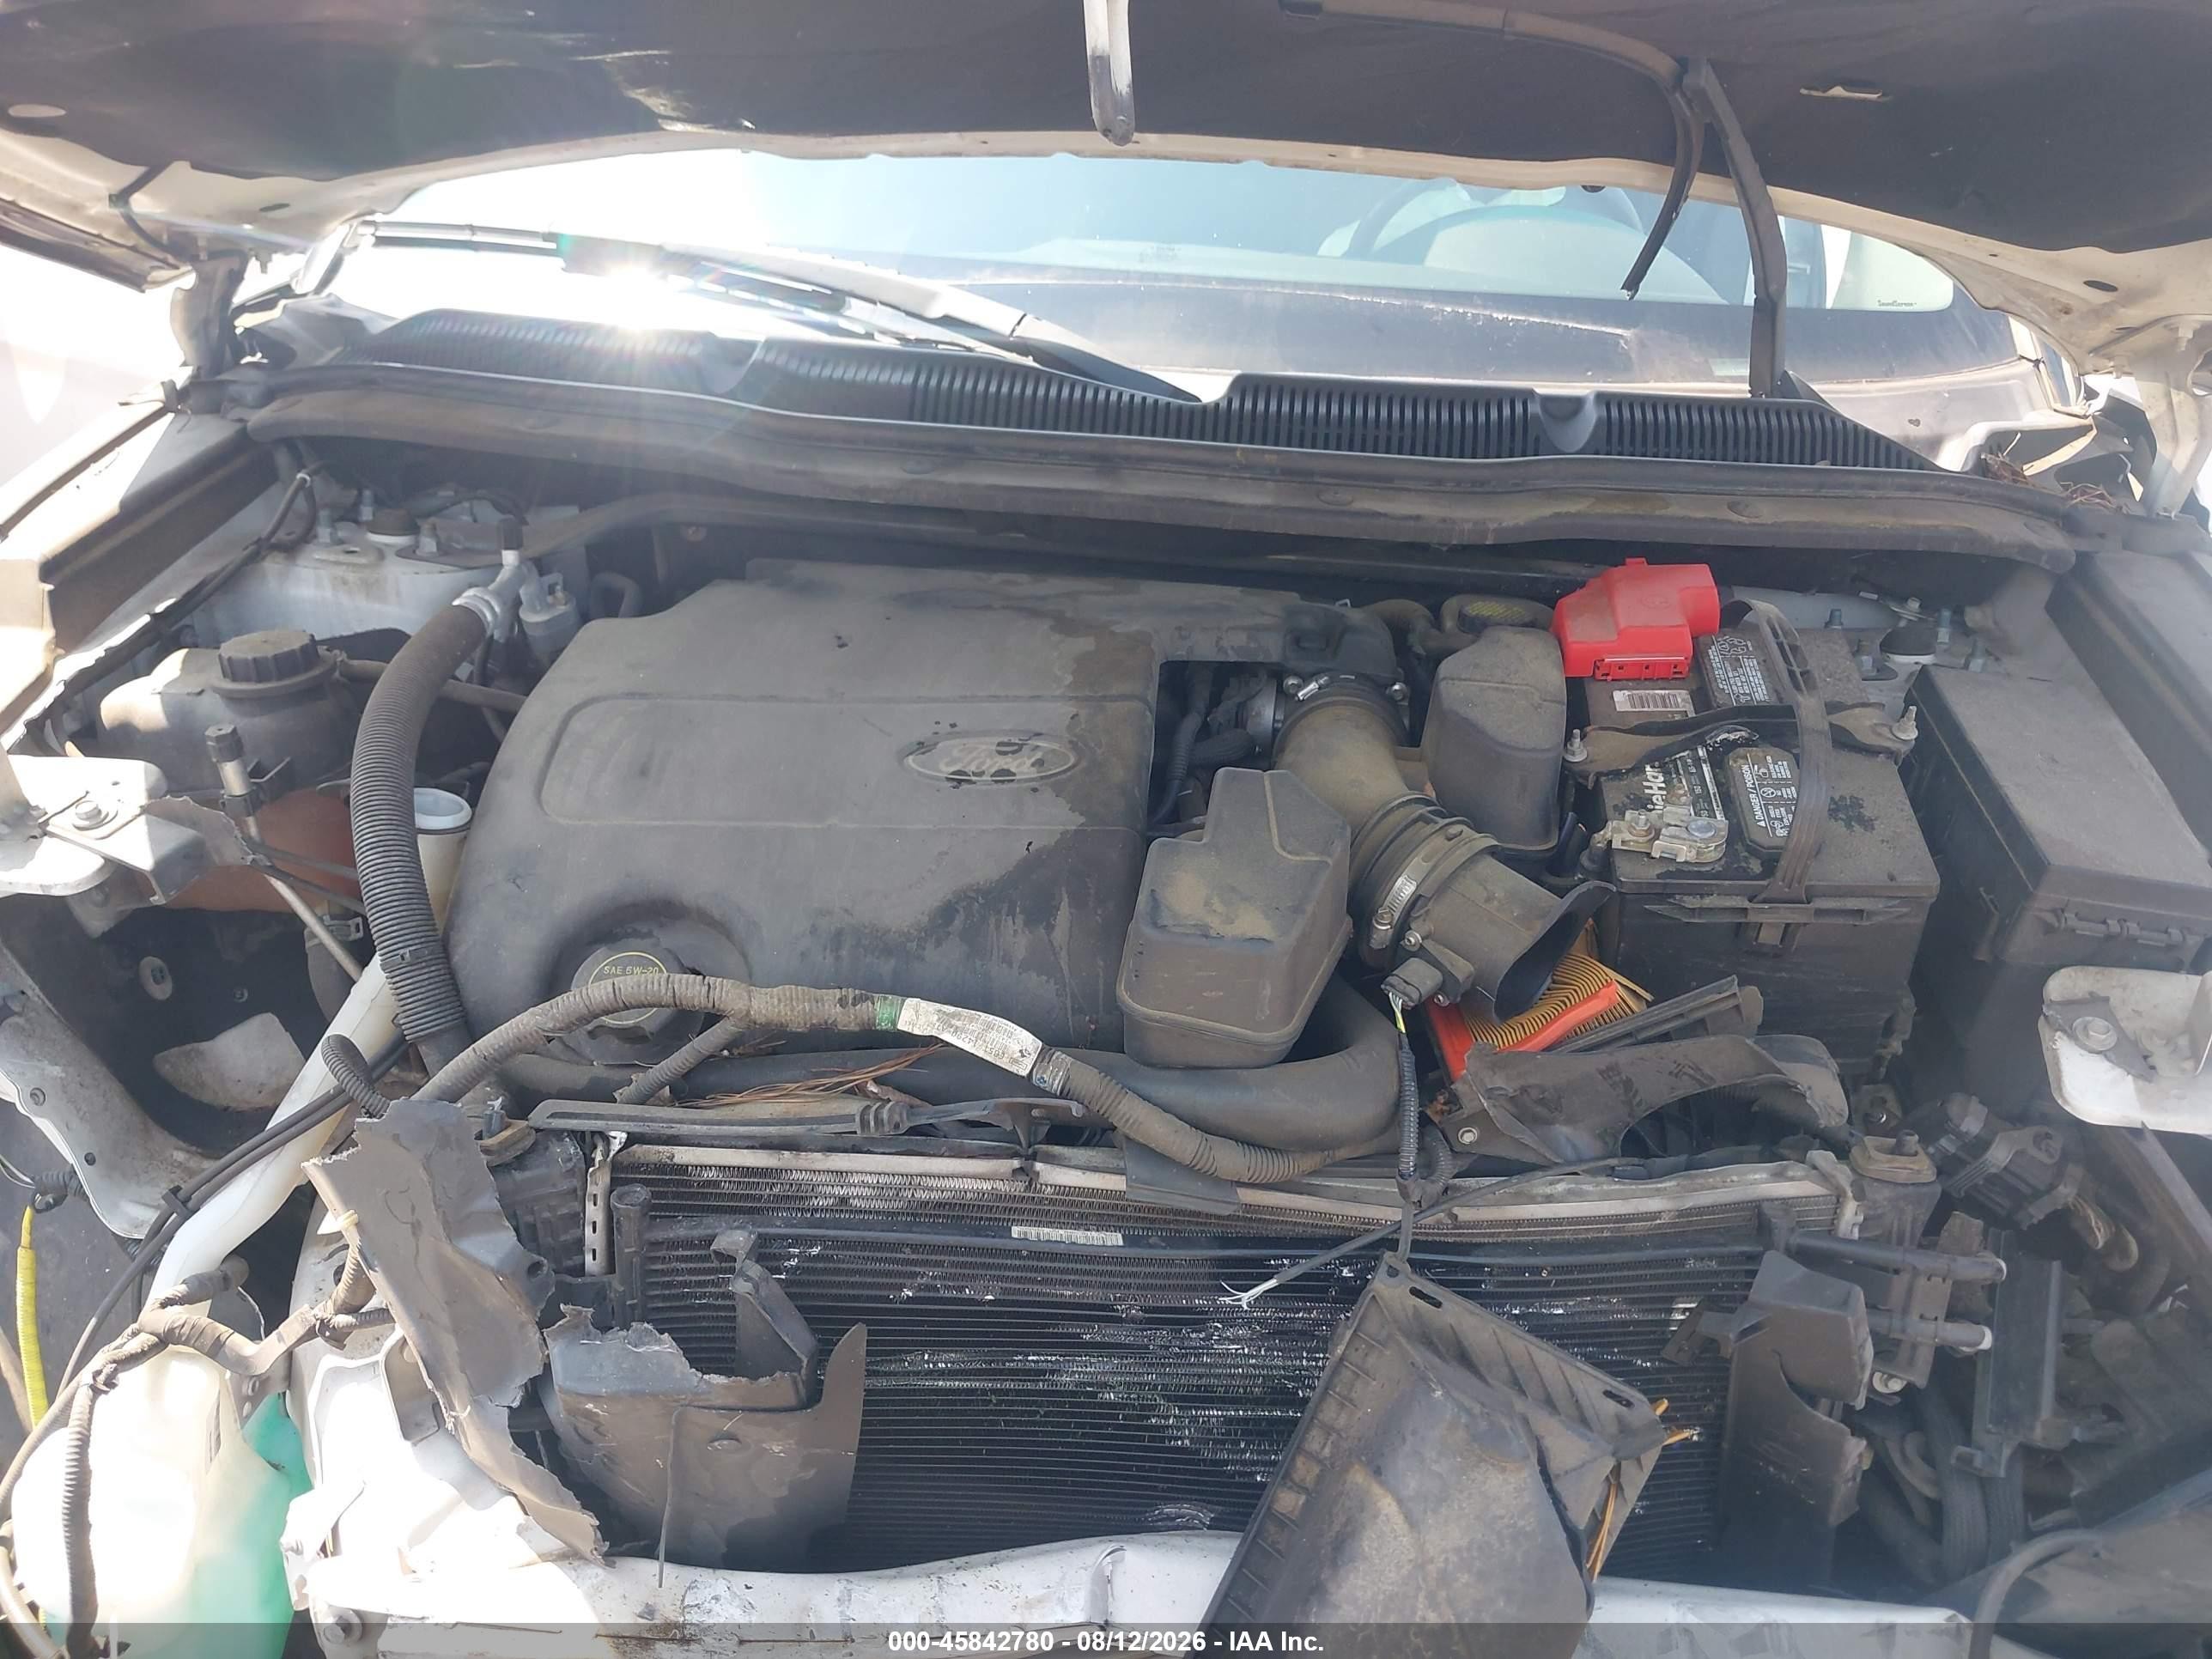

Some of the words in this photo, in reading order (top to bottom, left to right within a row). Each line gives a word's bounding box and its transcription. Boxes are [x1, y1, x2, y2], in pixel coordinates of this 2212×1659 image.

[1642, 764, 1668, 810] ieHar
[1741, 764, 1755, 788] POISON
[1749, 793, 1765, 821] DANGER
[604, 965, 623, 975] SAE
